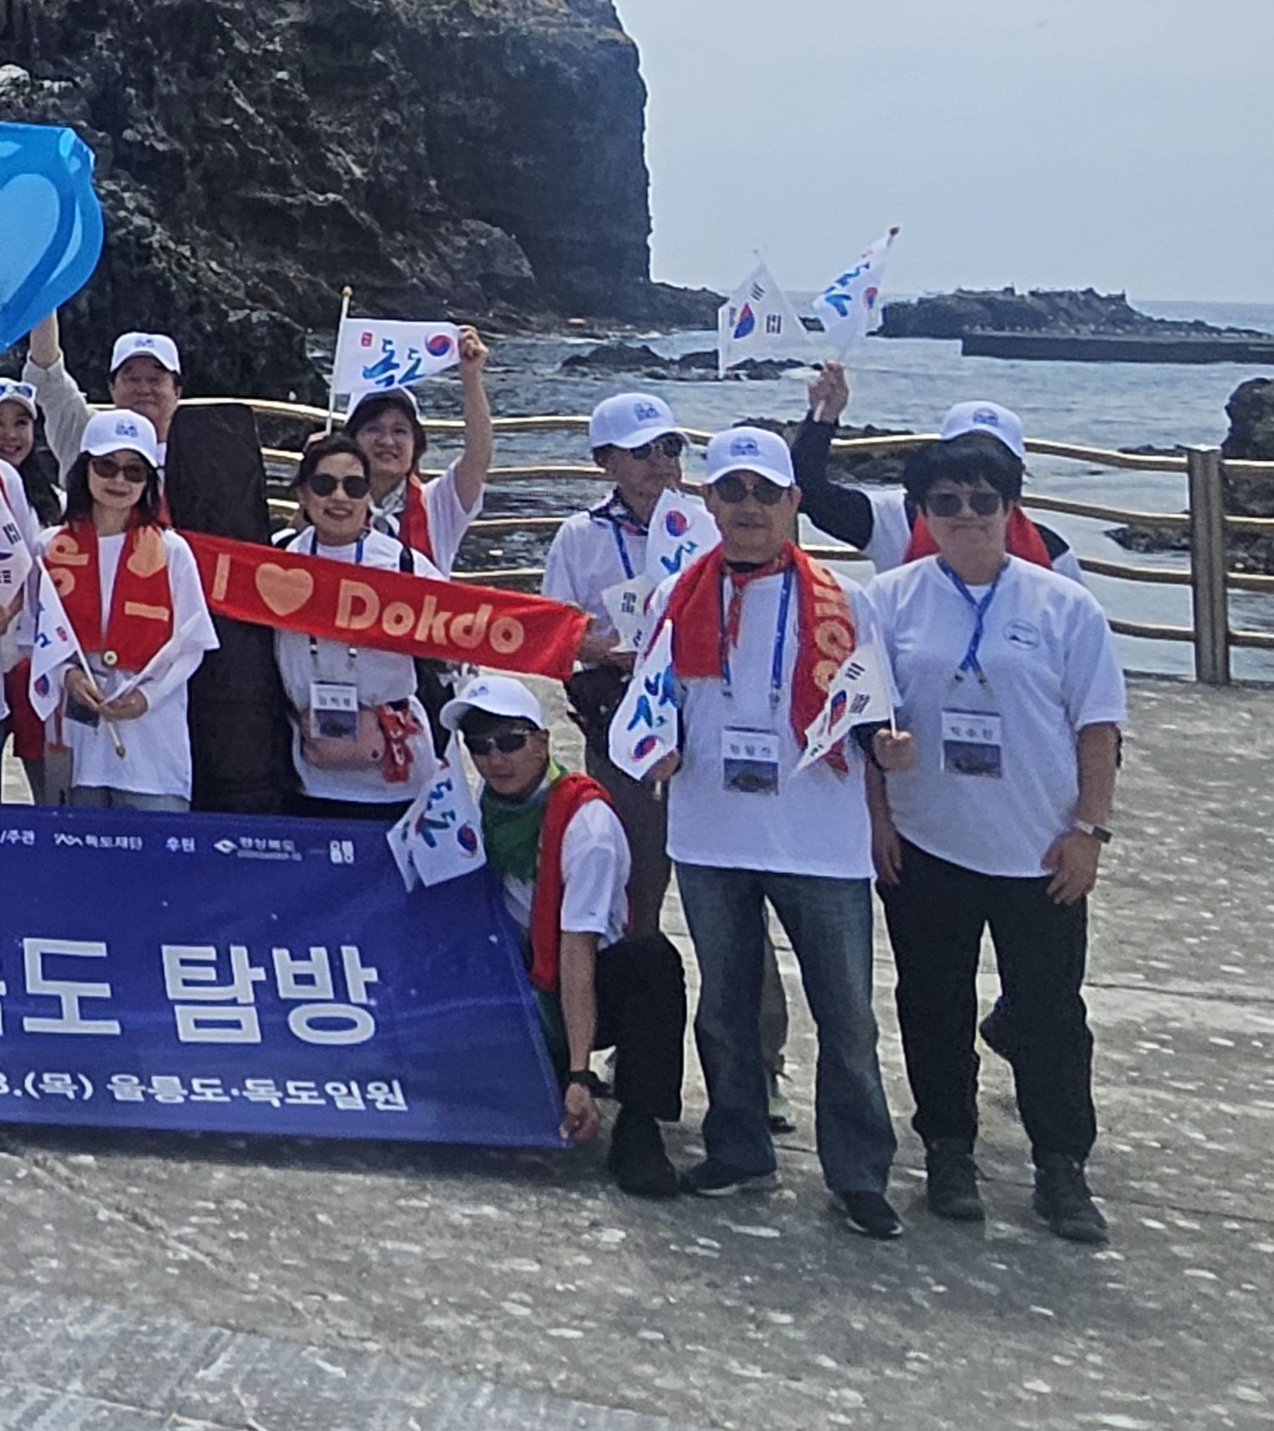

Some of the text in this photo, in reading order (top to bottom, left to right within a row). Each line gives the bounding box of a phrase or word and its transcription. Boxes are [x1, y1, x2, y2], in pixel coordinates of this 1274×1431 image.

[211, 553, 525, 654] I Dokdo
[160, 943, 379, 1045] 탐방
[105, 1073, 410, 1112] 울릉도·독도일원
